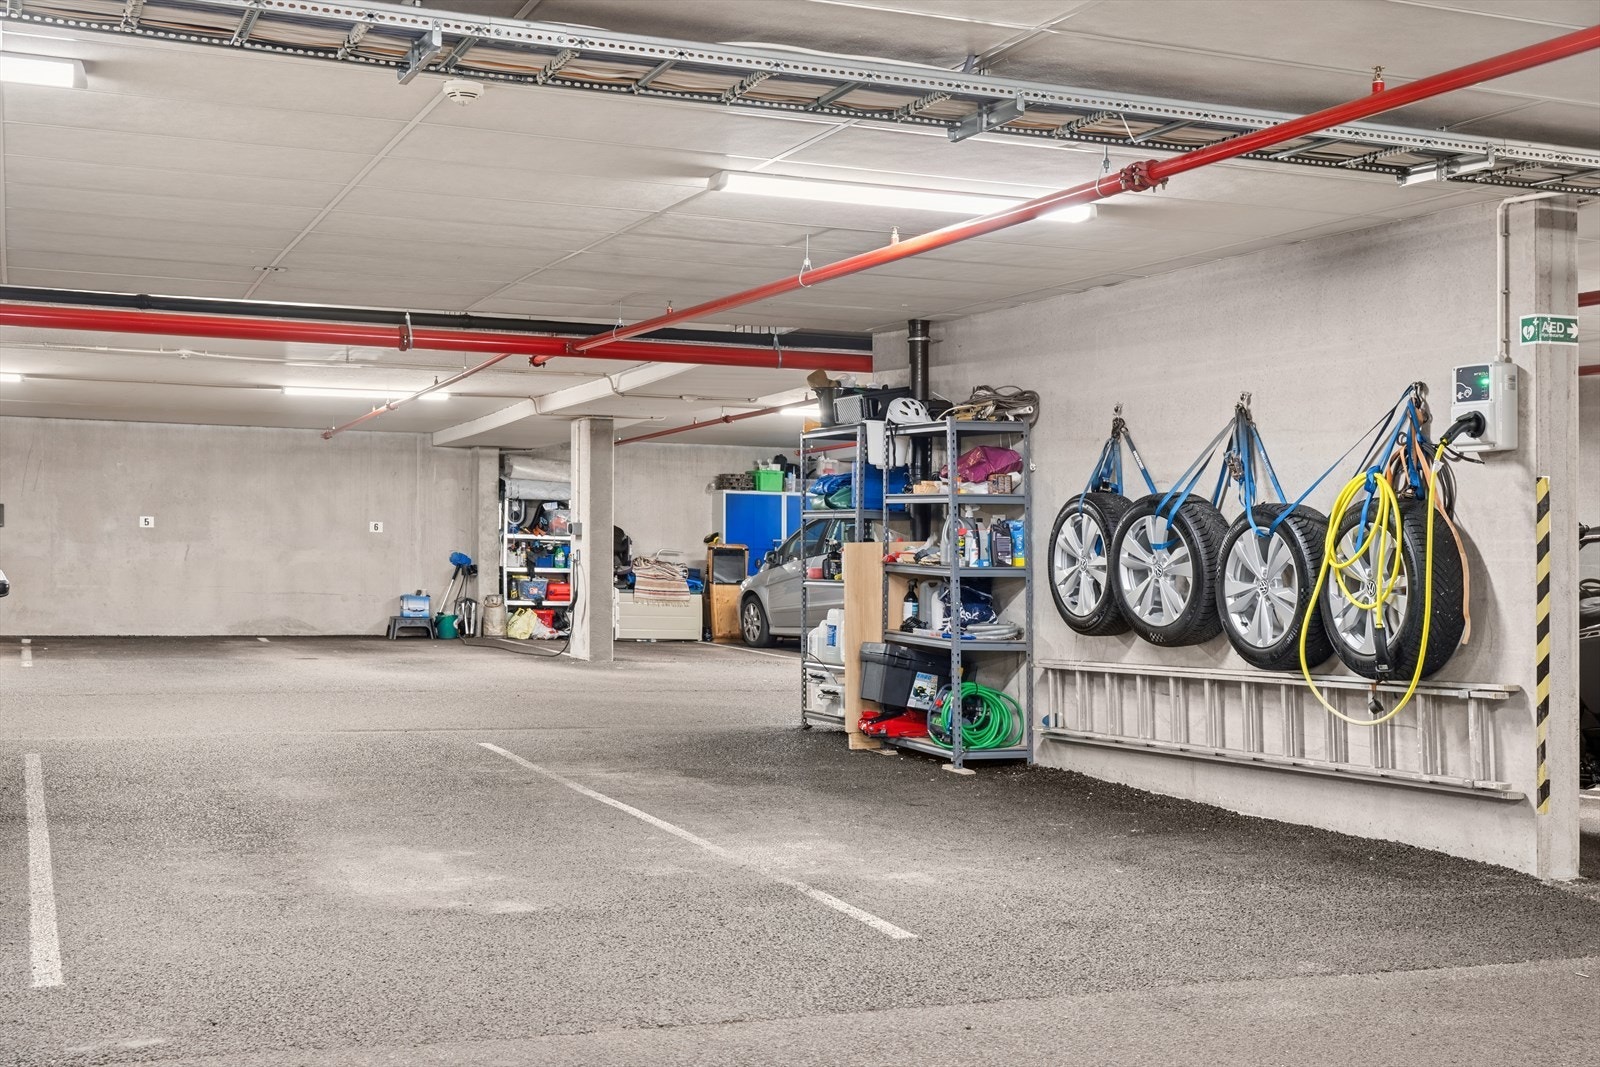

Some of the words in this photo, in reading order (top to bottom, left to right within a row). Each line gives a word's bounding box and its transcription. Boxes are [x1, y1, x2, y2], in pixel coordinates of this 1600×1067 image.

[1542, 322, 1564, 334] AED
[144, 518, 150, 526] 5
[374, 523, 378, 532] 6
